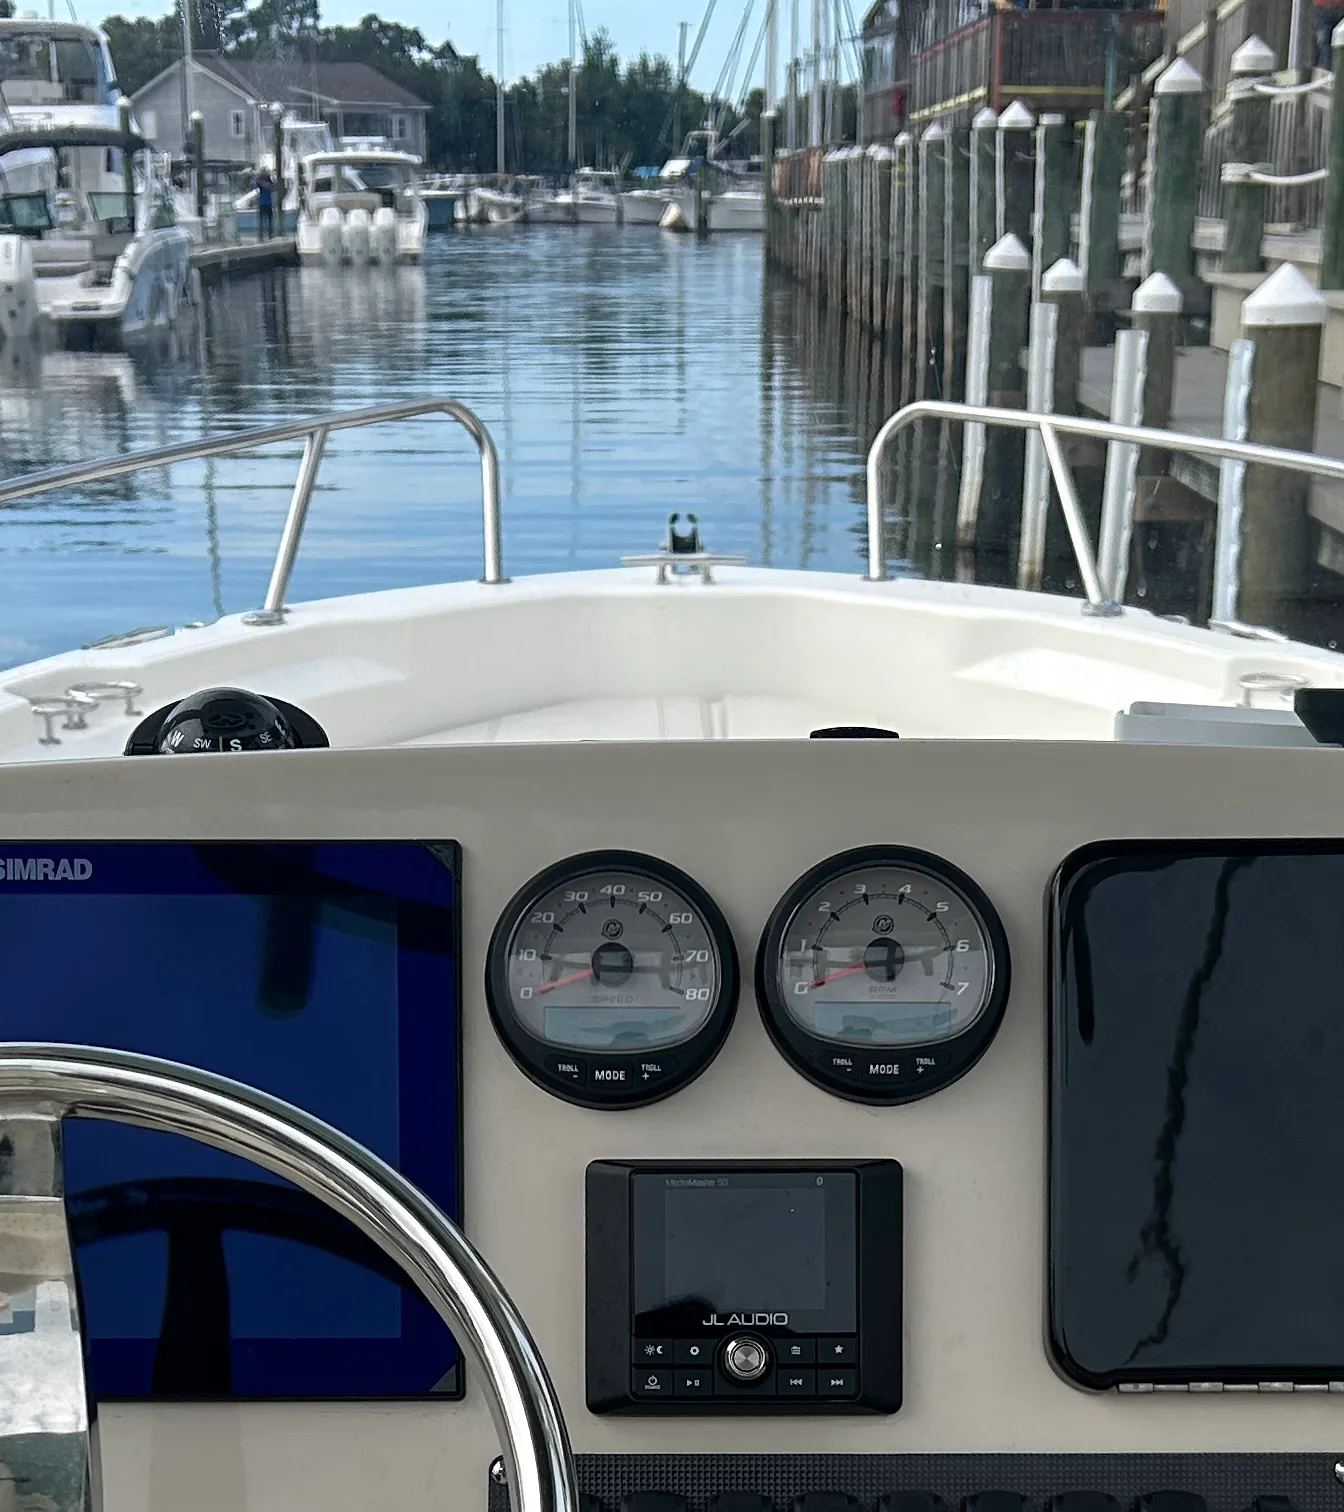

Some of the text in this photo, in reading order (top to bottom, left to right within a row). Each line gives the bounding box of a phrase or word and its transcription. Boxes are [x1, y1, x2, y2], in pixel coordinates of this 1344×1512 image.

[193, 738, 211, 749] SW
[230, 739, 242, 751] S
[260, 731, 272, 743] SE
[600, 885, 626, 895] 40
[854, 884, 866, 894] 3
[898, 884, 912, 894] 4
[564, 891, 588, 901] 30
[637, 891, 663, 902] 50
[818, 902, 831, 912] 2
[936, 902, 949, 912] 5
[531, 912, 554, 923] 20
[669, 913, 693, 924] 60
[800, 939, 806, 950] 1
[956, 940, 970, 952] 6
[519, 949, 536, 961] 10
[685, 950, 709, 962] 70
[520, 987, 533, 999] 0
[794, 982, 808, 994] 0
[957, 982, 970, 995] 7
[686, 988, 710, 1000] 80
[869, 1064, 900, 1074] MODE
[595, 1070, 626, 1081] MODE
[702, 1312, 788, 1326] JL AUDIO
